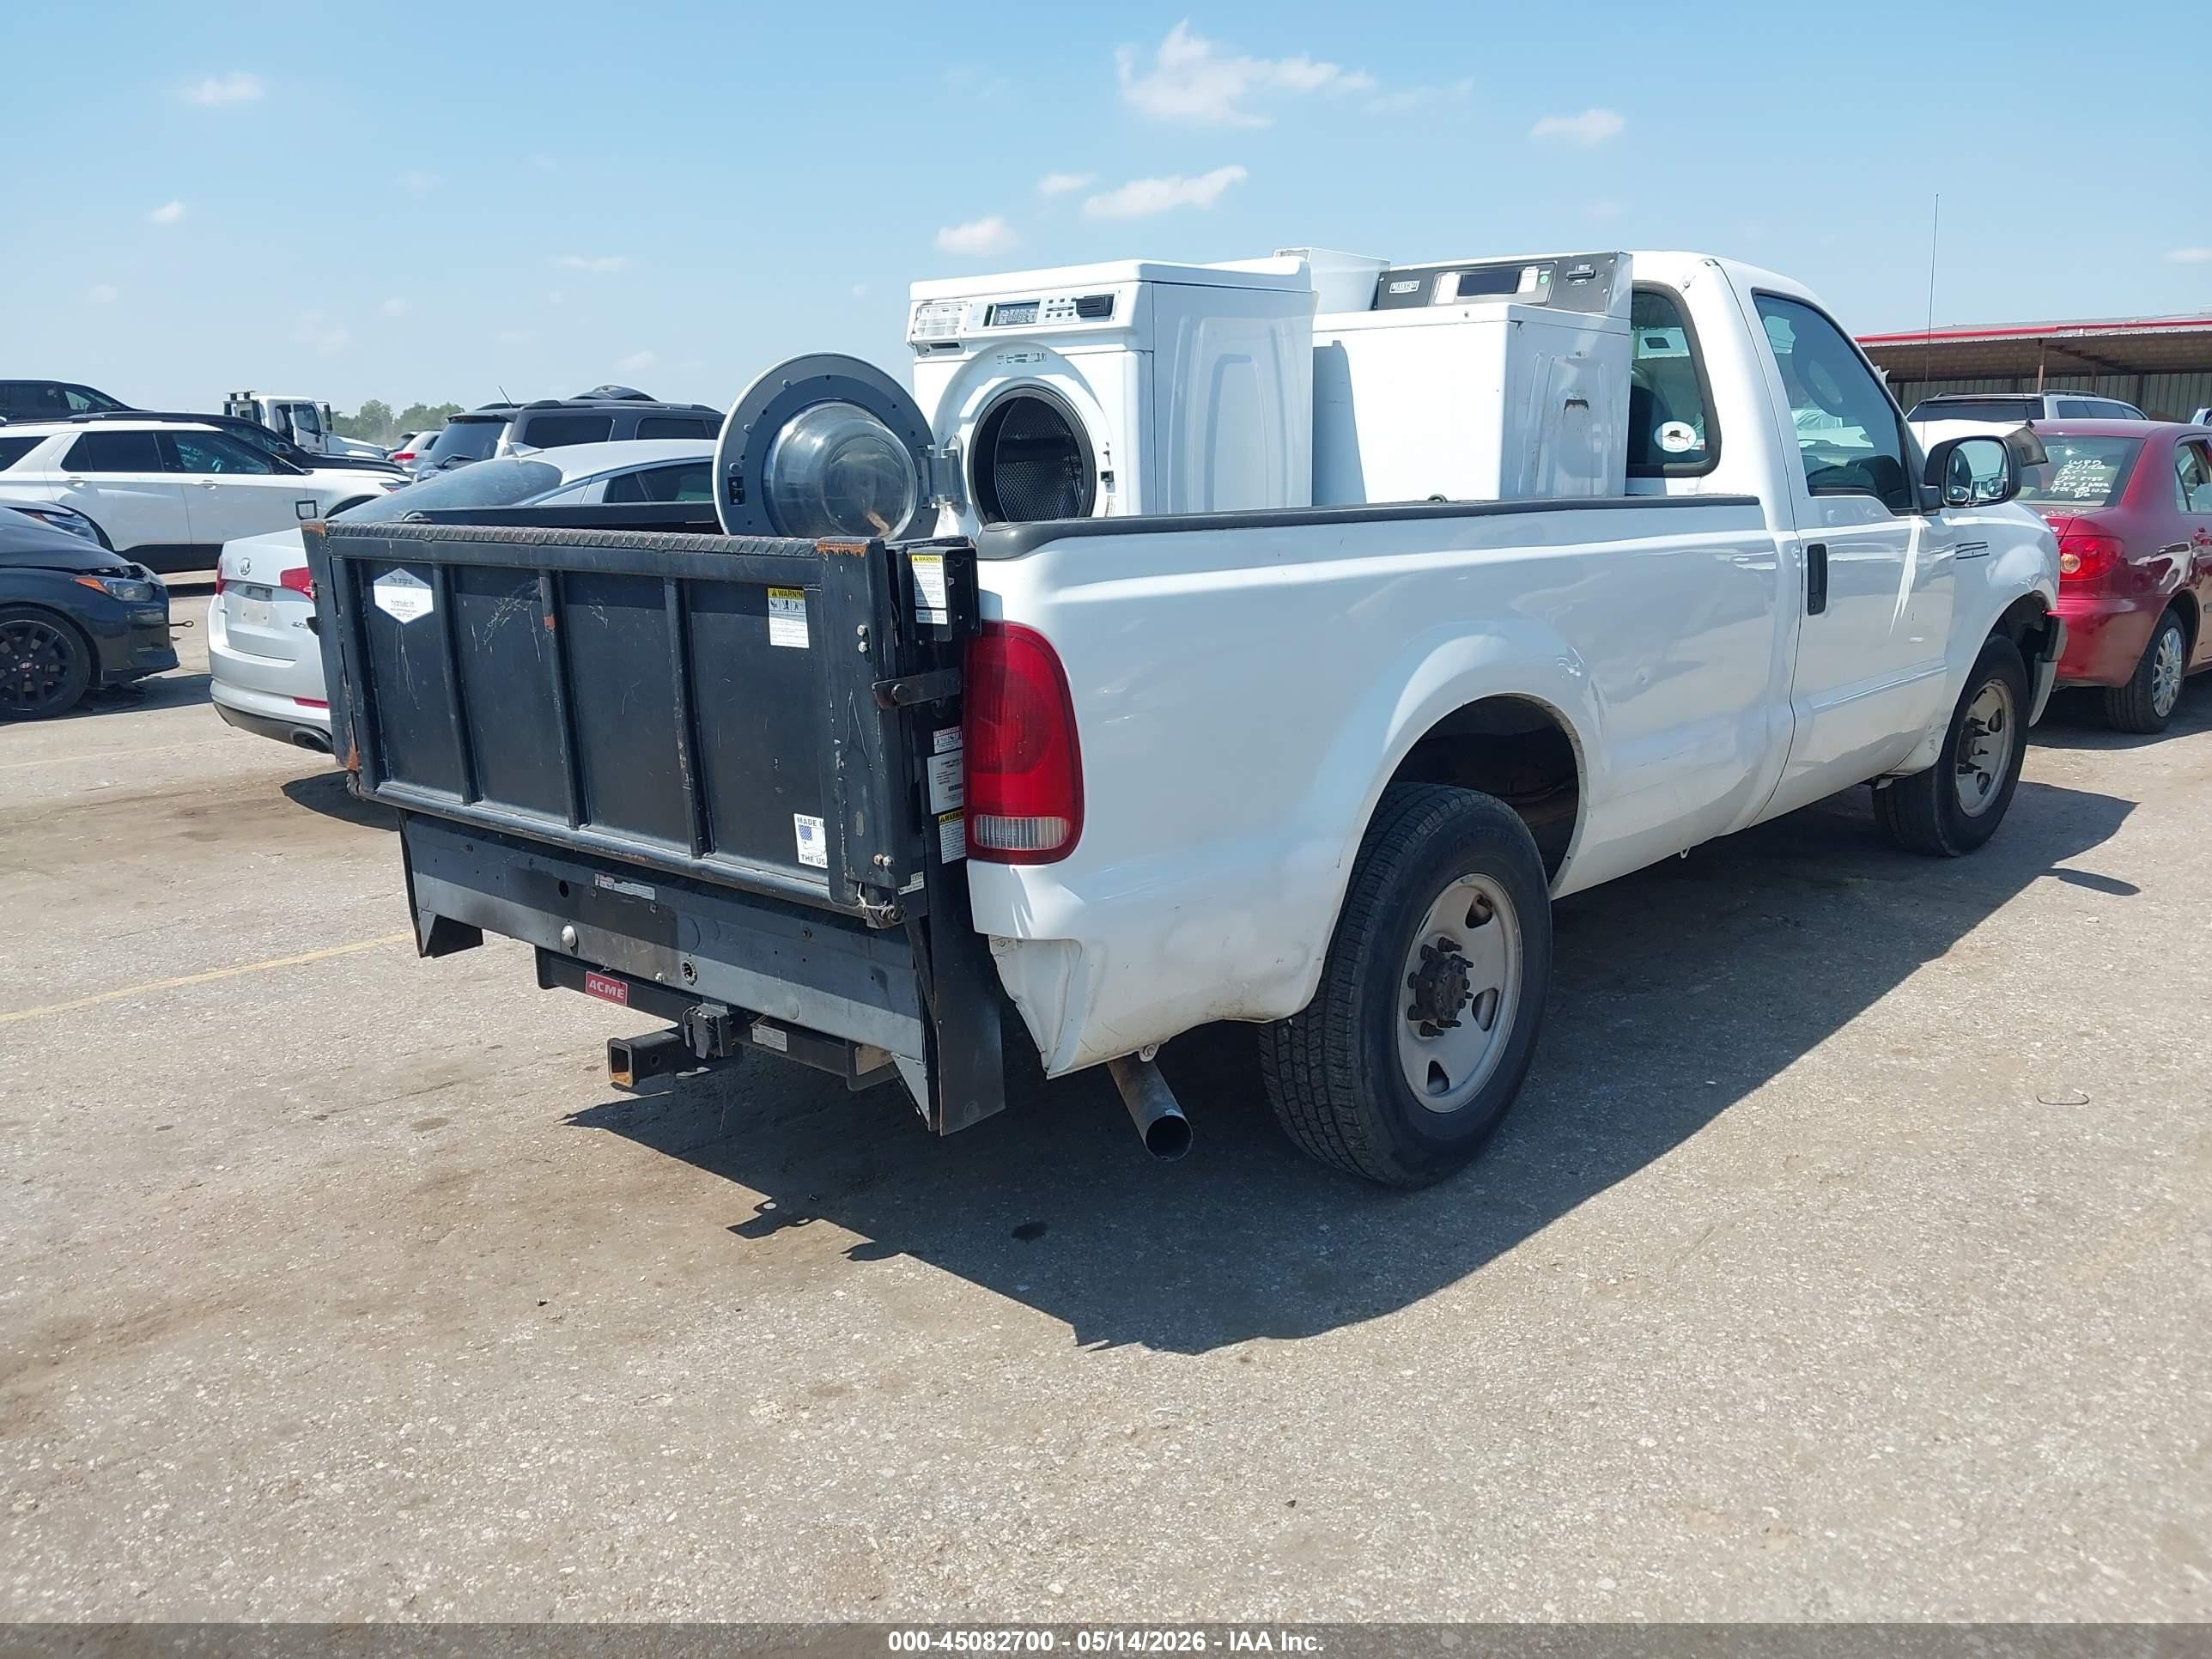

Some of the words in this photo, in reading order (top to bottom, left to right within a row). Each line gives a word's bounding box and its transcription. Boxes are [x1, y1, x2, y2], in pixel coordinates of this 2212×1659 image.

[778, 589, 805, 599] WARNIN
[797, 817, 817, 827] MADE
[800, 854, 815, 863] THE
[816, 857, 826, 866] US
[589, 979, 625, 1000] ACME
